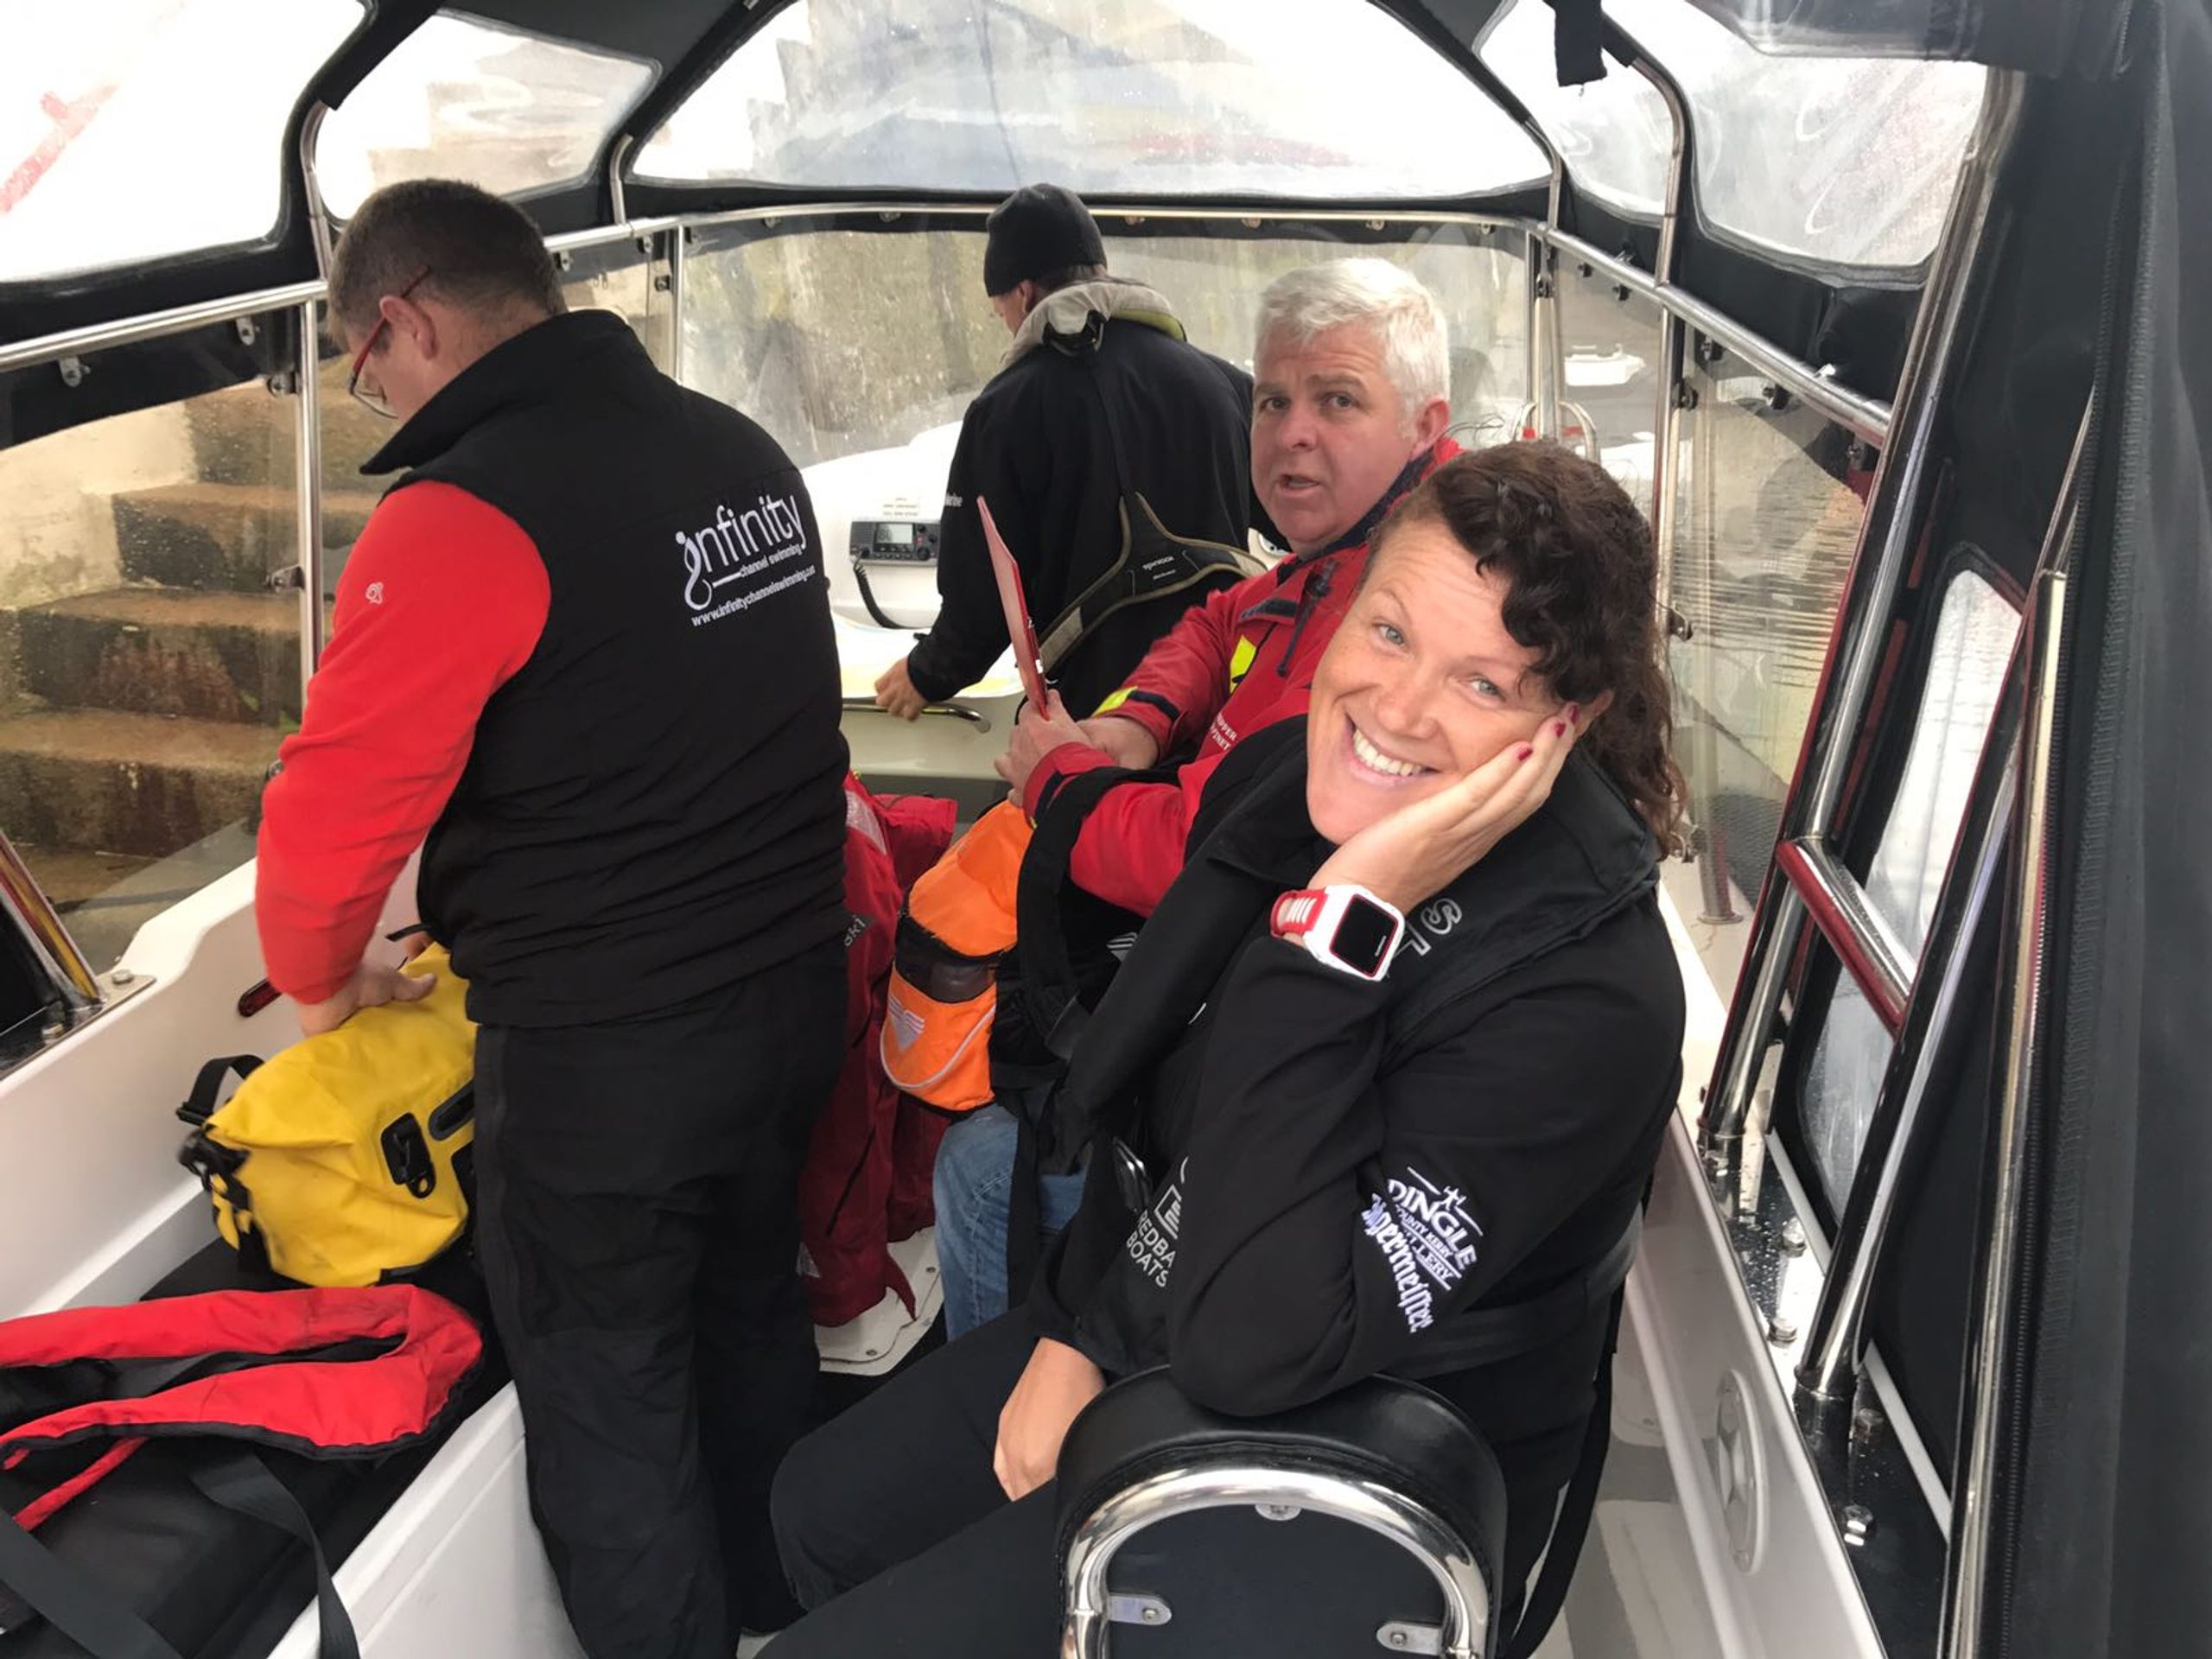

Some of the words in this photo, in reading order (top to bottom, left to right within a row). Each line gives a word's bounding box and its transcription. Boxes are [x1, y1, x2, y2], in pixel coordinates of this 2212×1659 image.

[676, 494, 806, 610] infinity
[740, 556, 769, 578] channel
[768, 543, 803, 565] swimming
[1127, 1230, 1169, 1287] BOATS
[1387, 1179, 1477, 1271] DINGLE
